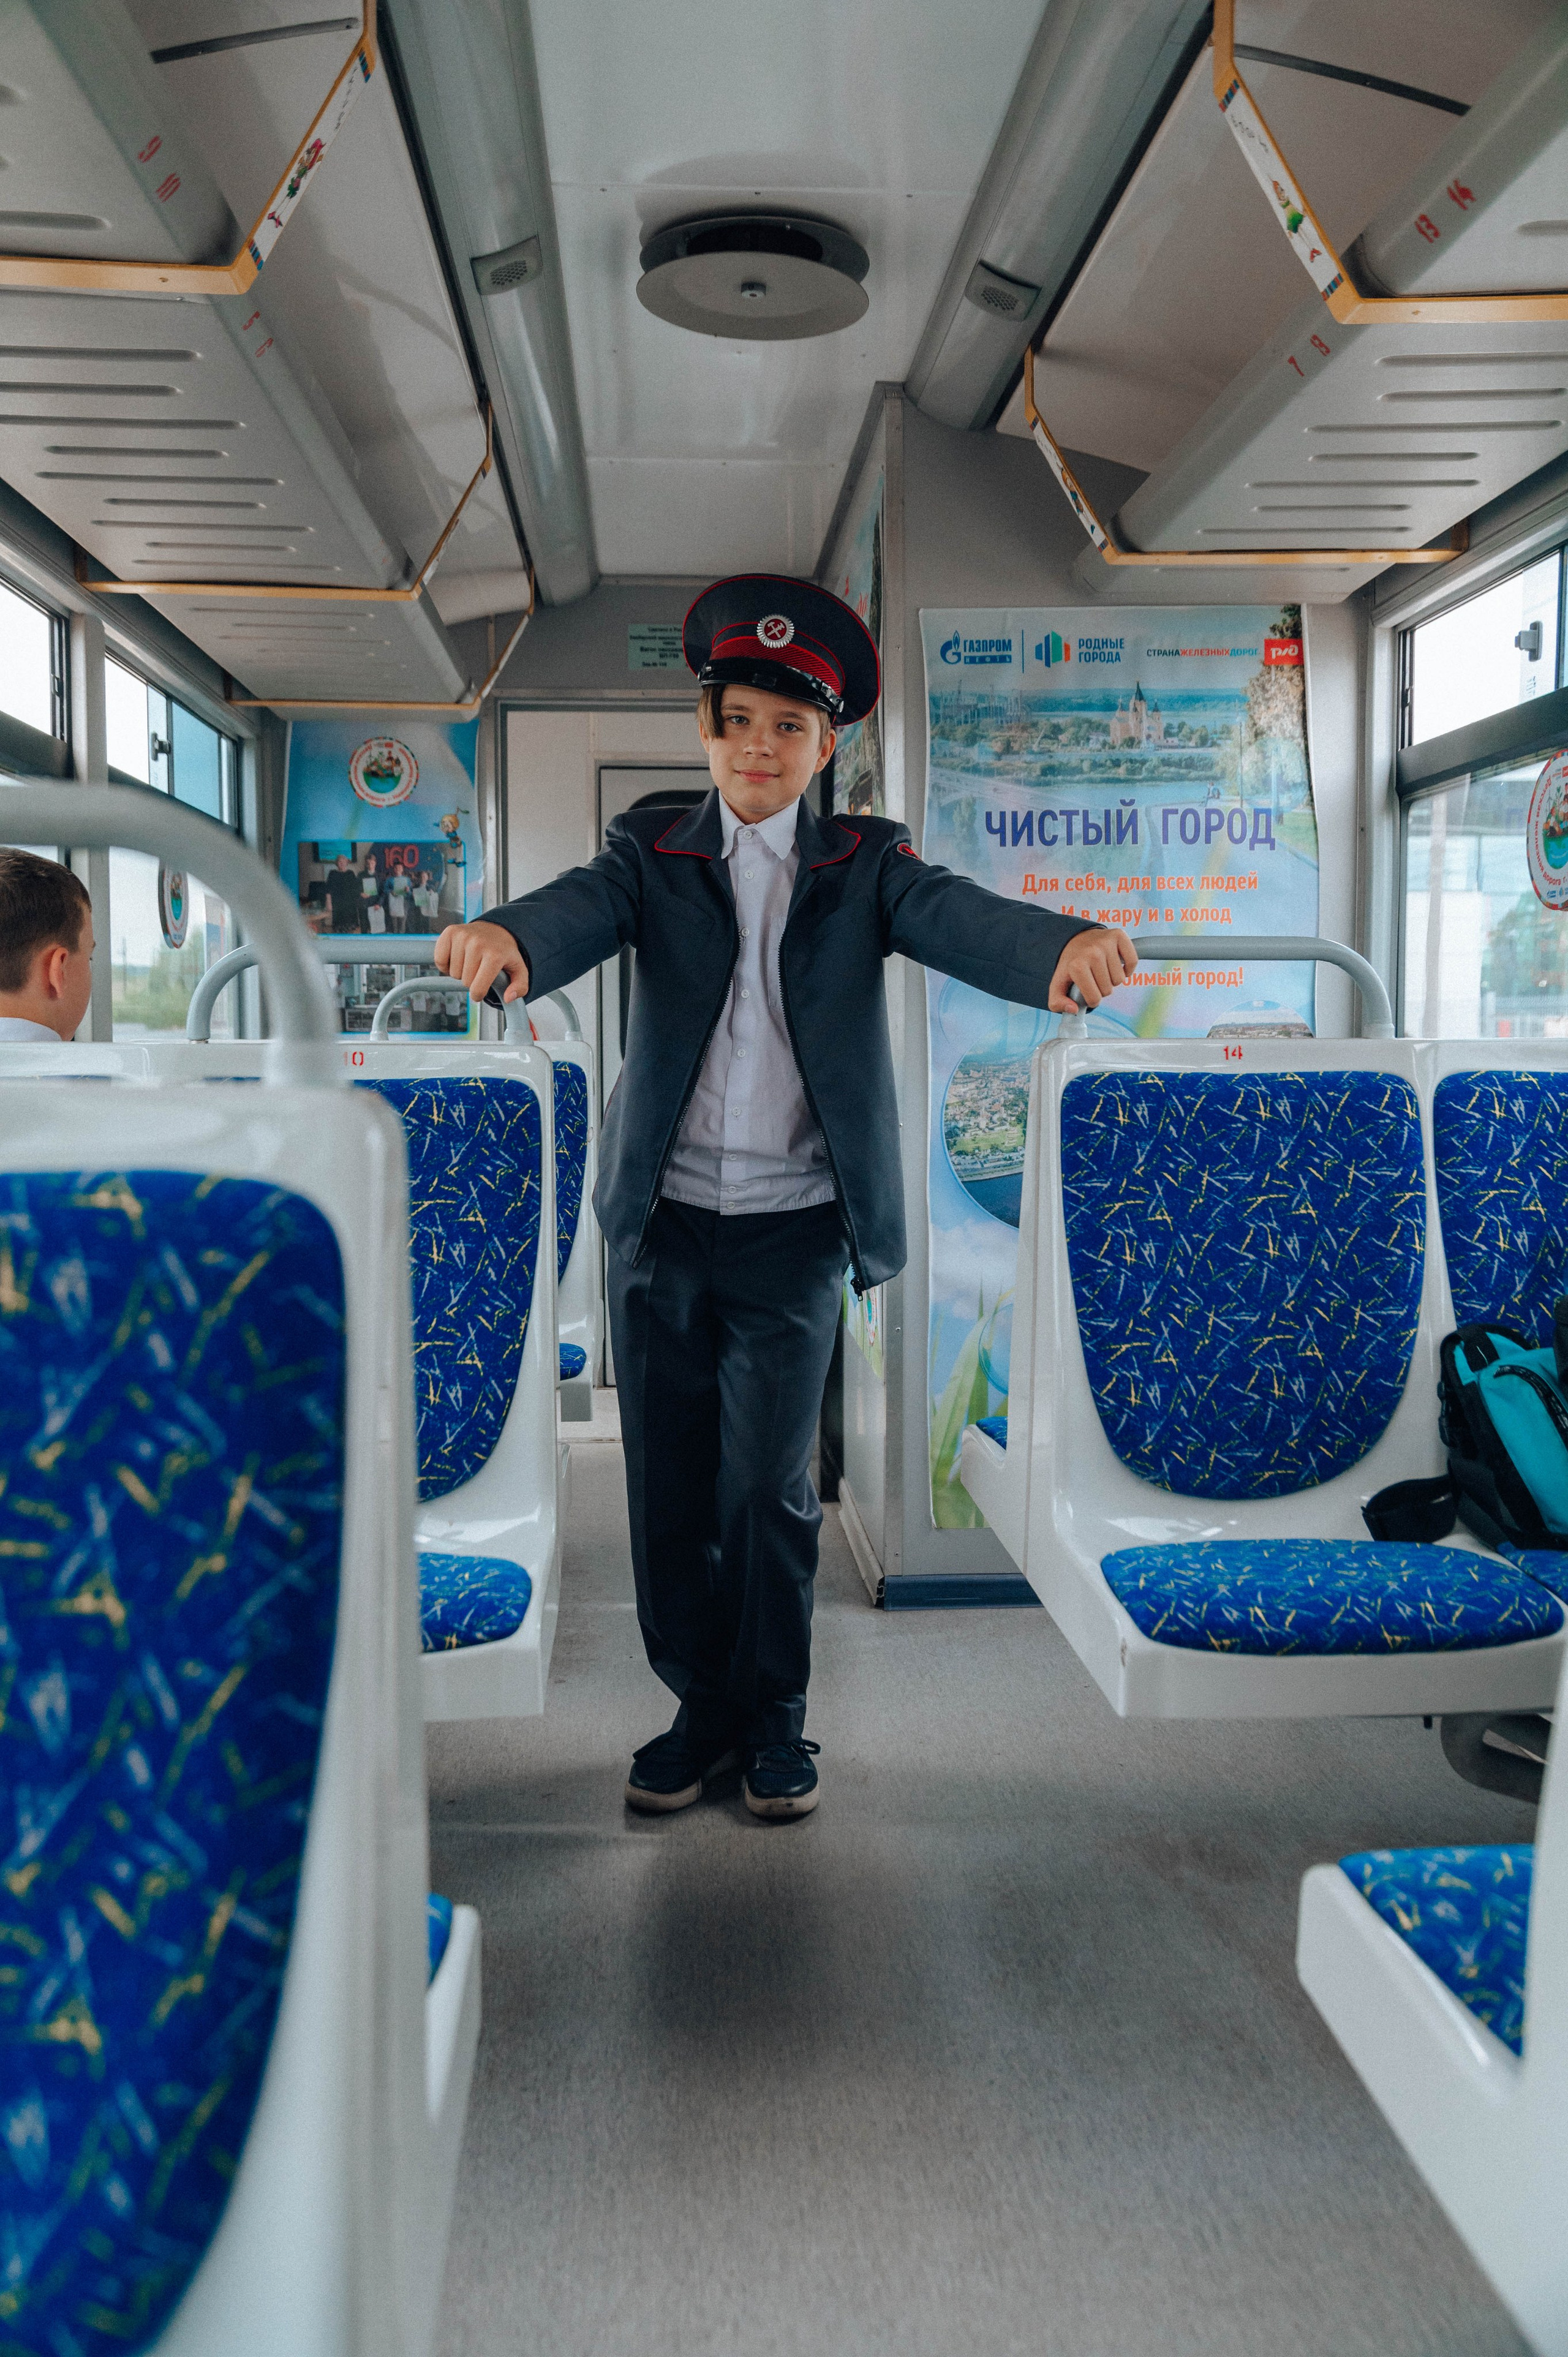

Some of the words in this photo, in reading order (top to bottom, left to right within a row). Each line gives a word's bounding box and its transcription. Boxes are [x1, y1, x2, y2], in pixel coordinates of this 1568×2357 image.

[1414, 213, 1441, 243] 13
[963, 639, 1012, 652] ГАЗПРОМ
[1079, 638, 1125, 650] РОДНЫЕ
[1079, 651, 1121, 663] ГОРОДА
[986, 798, 1139, 847] ЧИСТЫЙ
[1162, 807, 1276, 851] ГОРОД
[1022, 873, 1059, 896] Для
[1065, 872, 1112, 894] себя,
[1117, 876, 1151, 894] для
[1156, 876, 1194, 891] всех
[1199, 870, 1259, 893] людей
[1096, 908, 1143, 927] жару
[1148, 908, 1159, 922] и
[1164, 908, 1175, 922] в
[1180, 908, 1232, 924] холод
[1188, 966, 1244, 990] город!
[1223, 1044, 1243, 1061] 14
